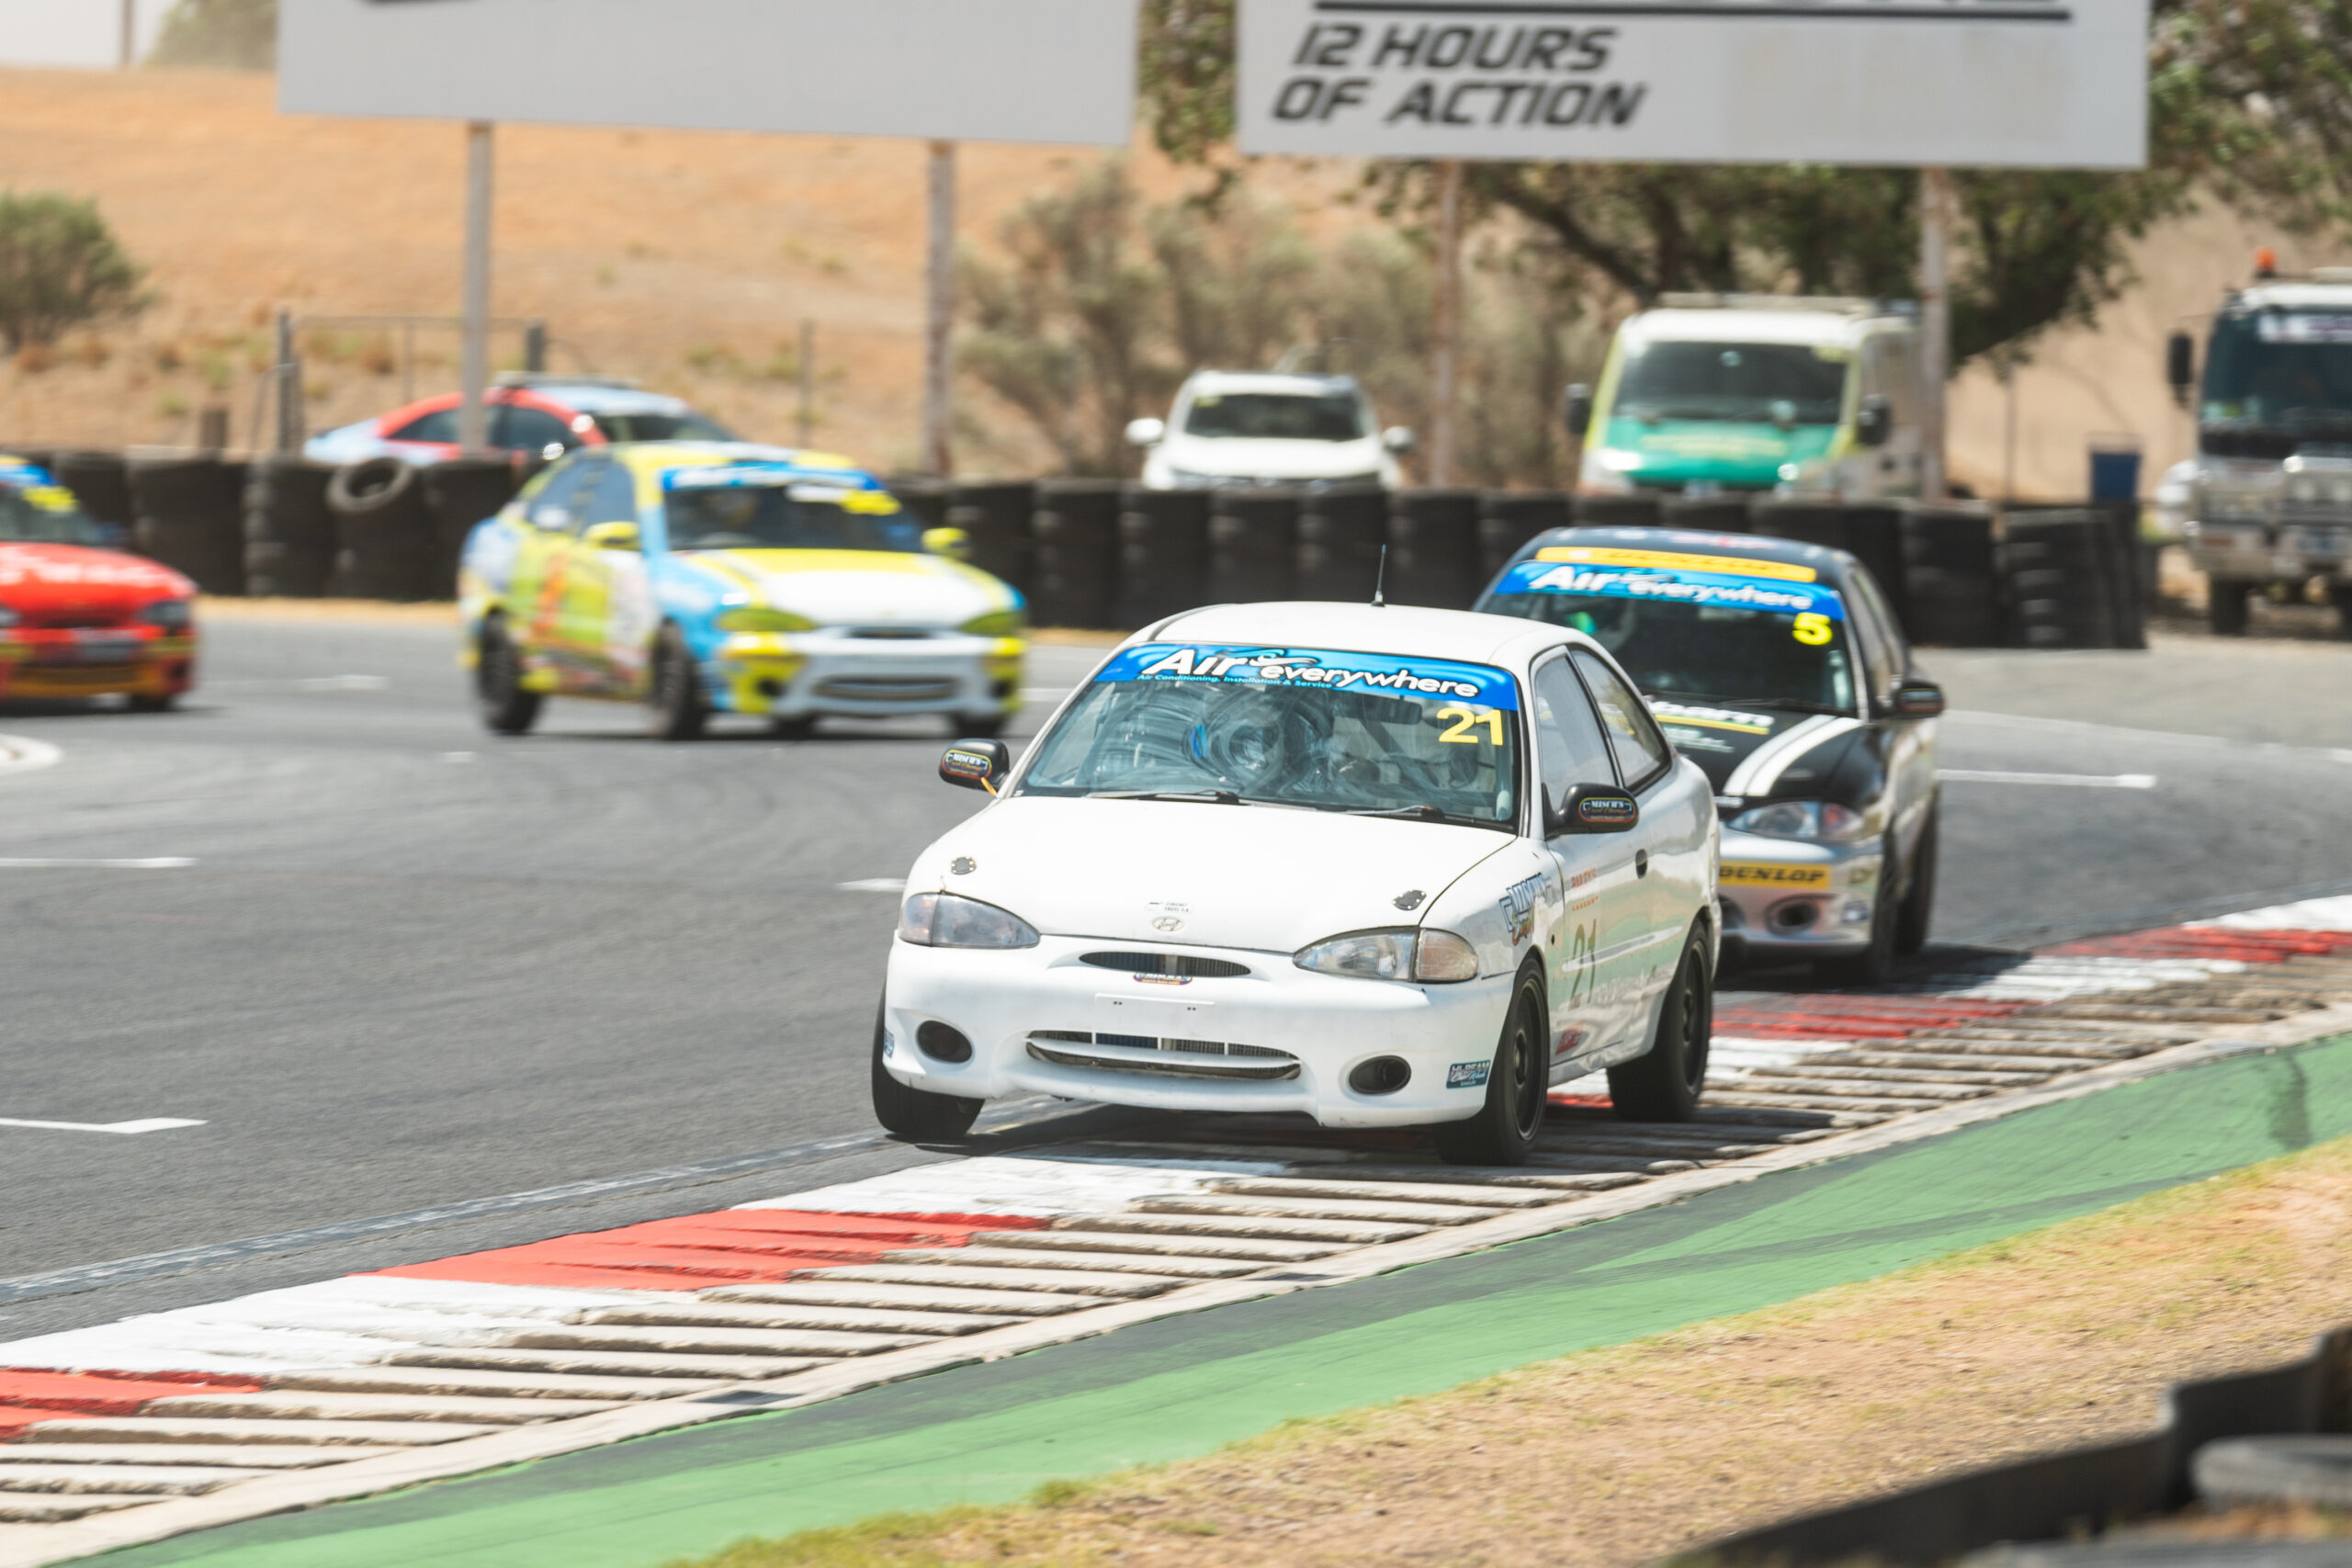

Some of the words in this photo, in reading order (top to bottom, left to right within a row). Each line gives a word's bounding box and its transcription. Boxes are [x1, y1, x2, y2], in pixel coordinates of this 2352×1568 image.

[1294, 23, 1363, 68] 12
[1370, 24, 1620, 72] HOURS
[1272, 75, 1373, 122] OF
[1384, 79, 1647, 127] ACTION
[1529, 565, 1620, 592] Air
[1628, 579, 1813, 610] everywhere
[1792, 612, 1833, 646] 5
[1141, 648, 1253, 677] Air
[1260, 664, 1479, 698] everywhere
[1223, 676, 1281, 685] Installation
[1283, 679, 1292, 687] &
[1294, 680, 1333, 689] Service
[1436, 706, 1504, 747] 21
[1719, 865, 1826, 883] DUNLOP
